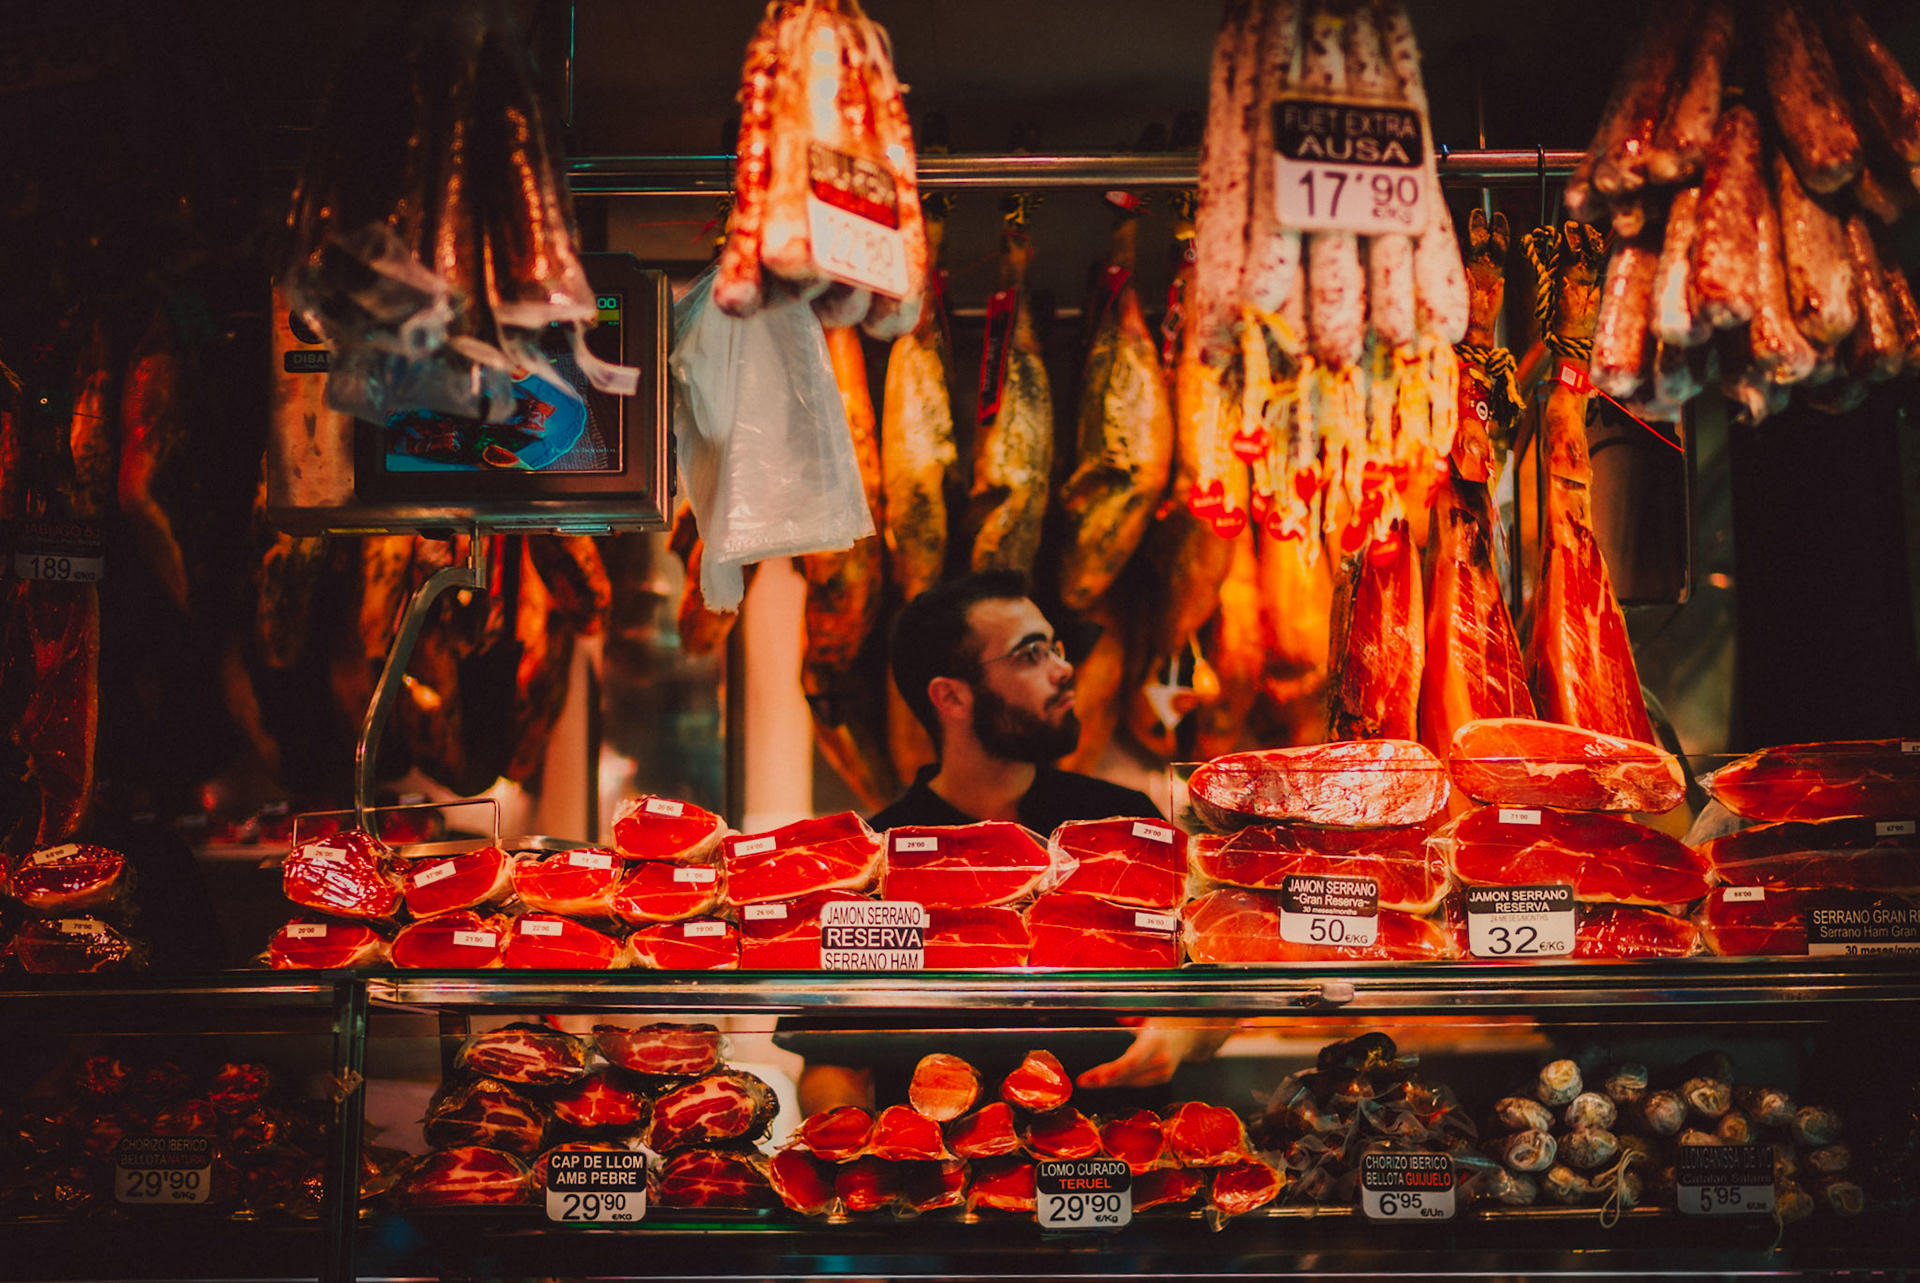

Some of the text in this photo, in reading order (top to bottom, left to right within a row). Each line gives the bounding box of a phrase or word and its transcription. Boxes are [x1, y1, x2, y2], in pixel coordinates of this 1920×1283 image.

[1284, 104, 1417, 139] FUET EXTRA
[1297, 134, 1411, 164] AUSA
[1299, 169, 1419, 218] 17'90
[31, 556, 71, 580] 189
[1288, 879, 1376, 897] JAMON SERRANO
[1469, 889, 1568, 902] JAMON SERRANO
[827, 906, 921, 925] JAMON SERRANO
[1495, 901, 1550, 912] RESERVA
[1813, 909, 1870, 924] SERRANO
[1872, 909, 1905, 924] GRAN
[827, 928, 922, 947] RESERVA
[1310, 918, 1369, 944] 50 €/KG
[1488, 926, 1565, 954] 32 €/KG
[1820, 925, 1917, 938] Serrano Ham Gran
[825, 952, 918, 970] SERRANO HAM
[121, 1138, 208, 1151] CHORIZO IBERICO
[120, 1154, 167, 1165] BELLOTA
[551, 1155, 643, 1169] CAP DE LLOM
[1365, 1156, 1448, 1170] CHORIZO IBERICO
[556, 1171, 637, 1184] AMB PEBRE
[1041, 1162, 1126, 1176] LOMO CURADO
[126, 1171, 200, 1197] 29'90
[1058, 1178, 1112, 1189] TERUEL
[1366, 1171, 1451, 1186] BELLOTA GUIJUELO
[562, 1194, 626, 1220] 29'90
[1379, 1193, 1444, 1217] 6'95 €/Un
[1700, 1186, 1742, 1212] 5'95
[1049, 1194, 1121, 1223] 29'90 €/Kg
